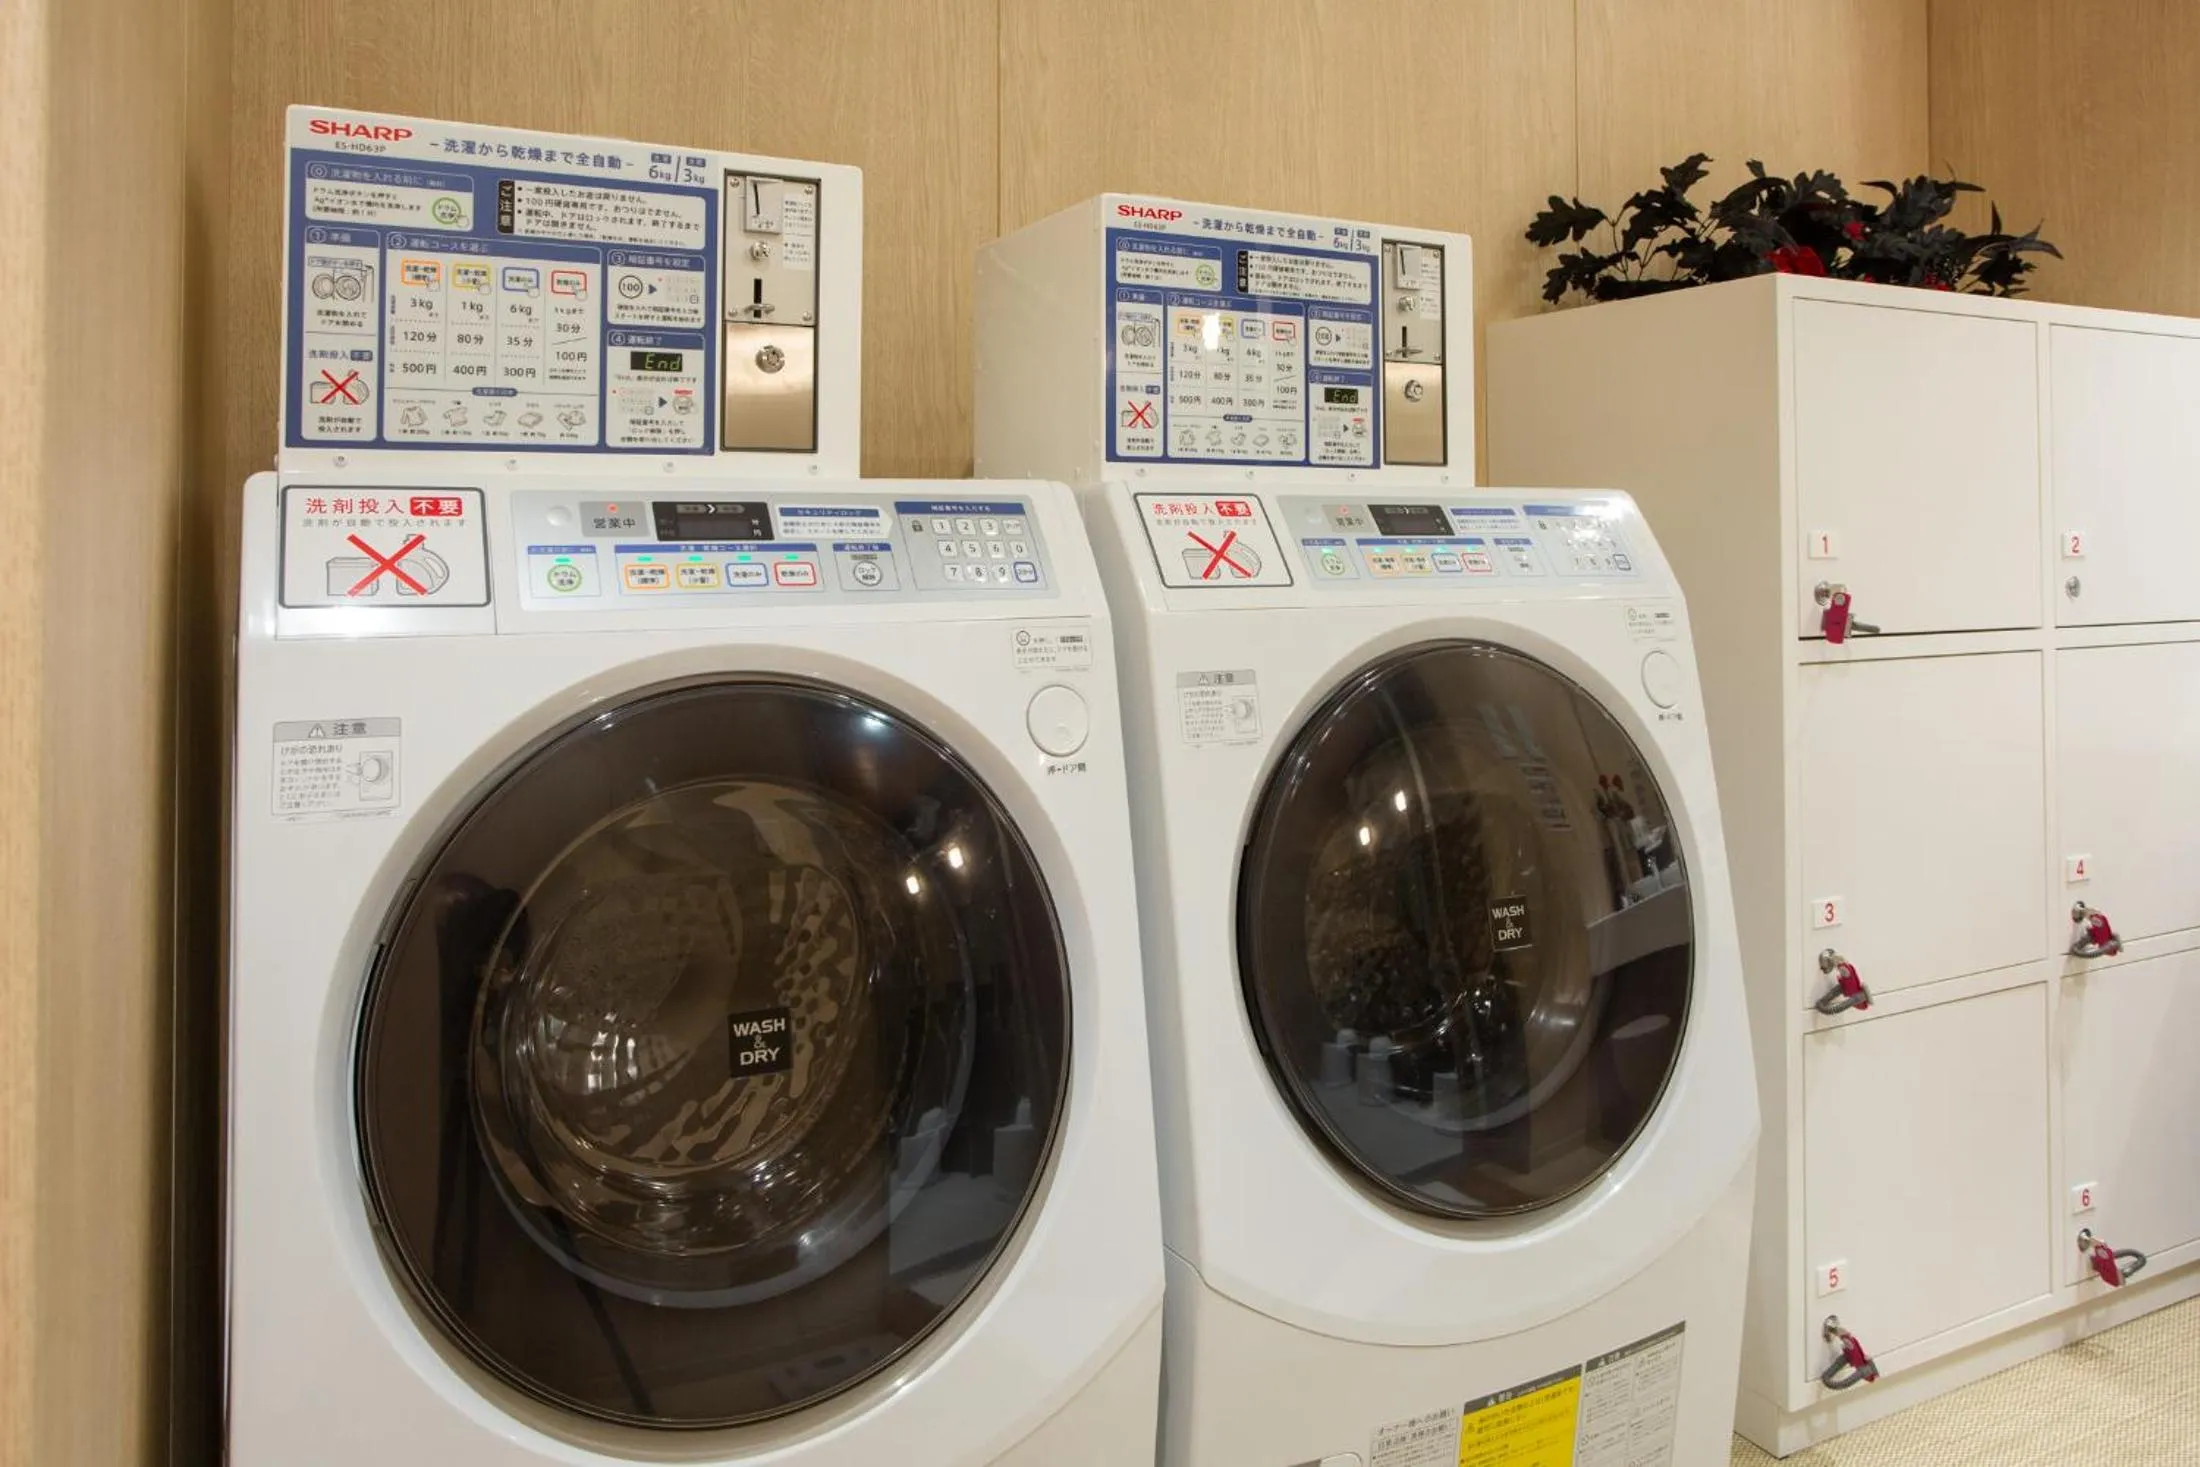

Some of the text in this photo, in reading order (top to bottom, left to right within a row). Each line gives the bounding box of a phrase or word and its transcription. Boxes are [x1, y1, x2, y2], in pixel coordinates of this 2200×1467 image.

[309, 119, 412, 141] SHARP
[335, 141, 387, 153] ES-HD63P
[1117, 204, 1183, 221] SHARP
[555, 351, 588, 362] 100円
[402, 362, 437, 375] 500円
[452, 365, 487, 377] 400円
[503, 366, 536, 378] 300円
[305, 496, 460, 516] 洗剤投入 不要
[302, 518, 466, 528] 洗剤が自動で投入されます
[593, 517, 637, 529] 営業中
[969, 544, 976, 553] 5
[1821, 536, 1828, 554] 1
[2071, 536, 2081, 554] 2
[950, 567, 957, 576] 7
[975, 567, 982, 577] 8
[998, 567, 1006, 576] 9
[2076, 859, 2085, 876] 4
[1491, 904, 1525, 919] WASH
[1825, 903, 1835, 922] 3
[1498, 927, 1523, 941] DRY
[733, 1018, 786, 1037] WASH
[740, 1047, 780, 1066] DRY
[2082, 1188, 2091, 1207] 6
[1828, 1268, 1839, 1288] 5
